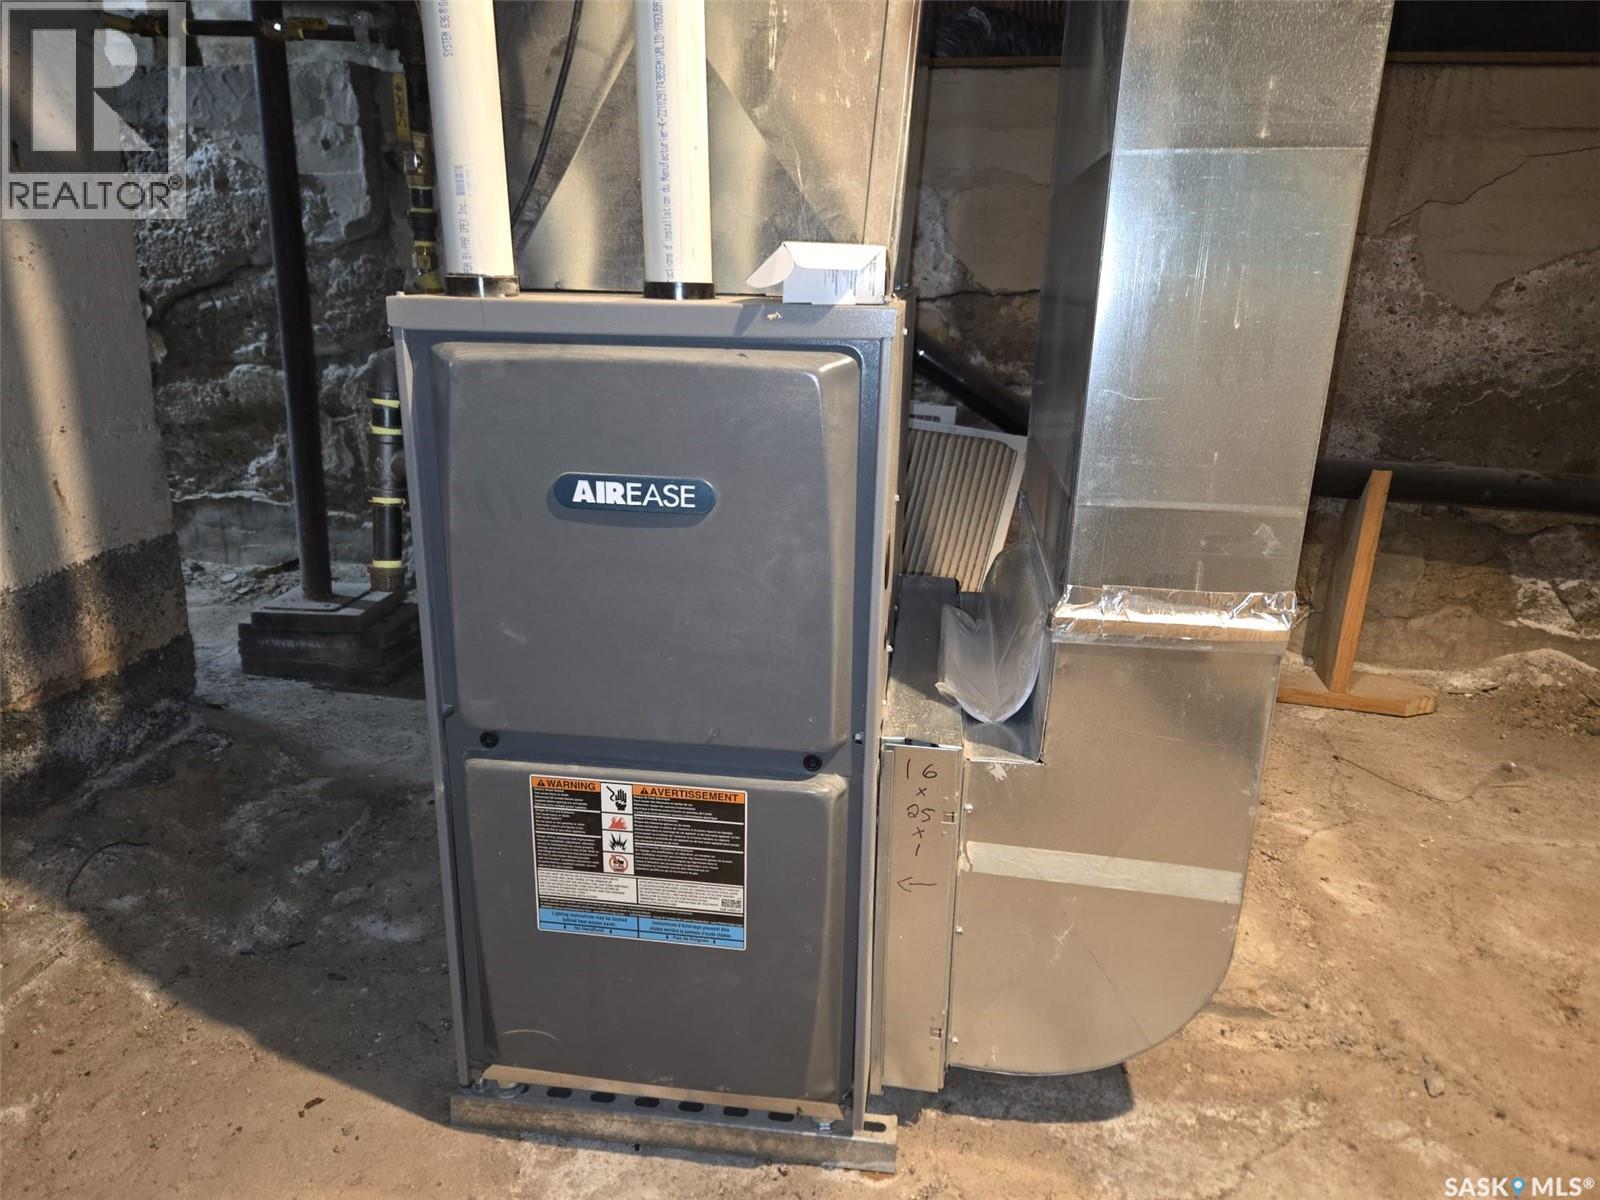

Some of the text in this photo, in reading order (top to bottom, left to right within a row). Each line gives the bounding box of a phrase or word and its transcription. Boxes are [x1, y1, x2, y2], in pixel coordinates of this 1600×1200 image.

[572, 480, 696, 508] AIREASE
[906, 758, 938, 780] 16
[546, 780, 596, 790] WARNING
[650, 788, 739, 802] AVERTISSEMENT
[906, 804, 936, 823] 25
[914, 844, 921, 856] 1
